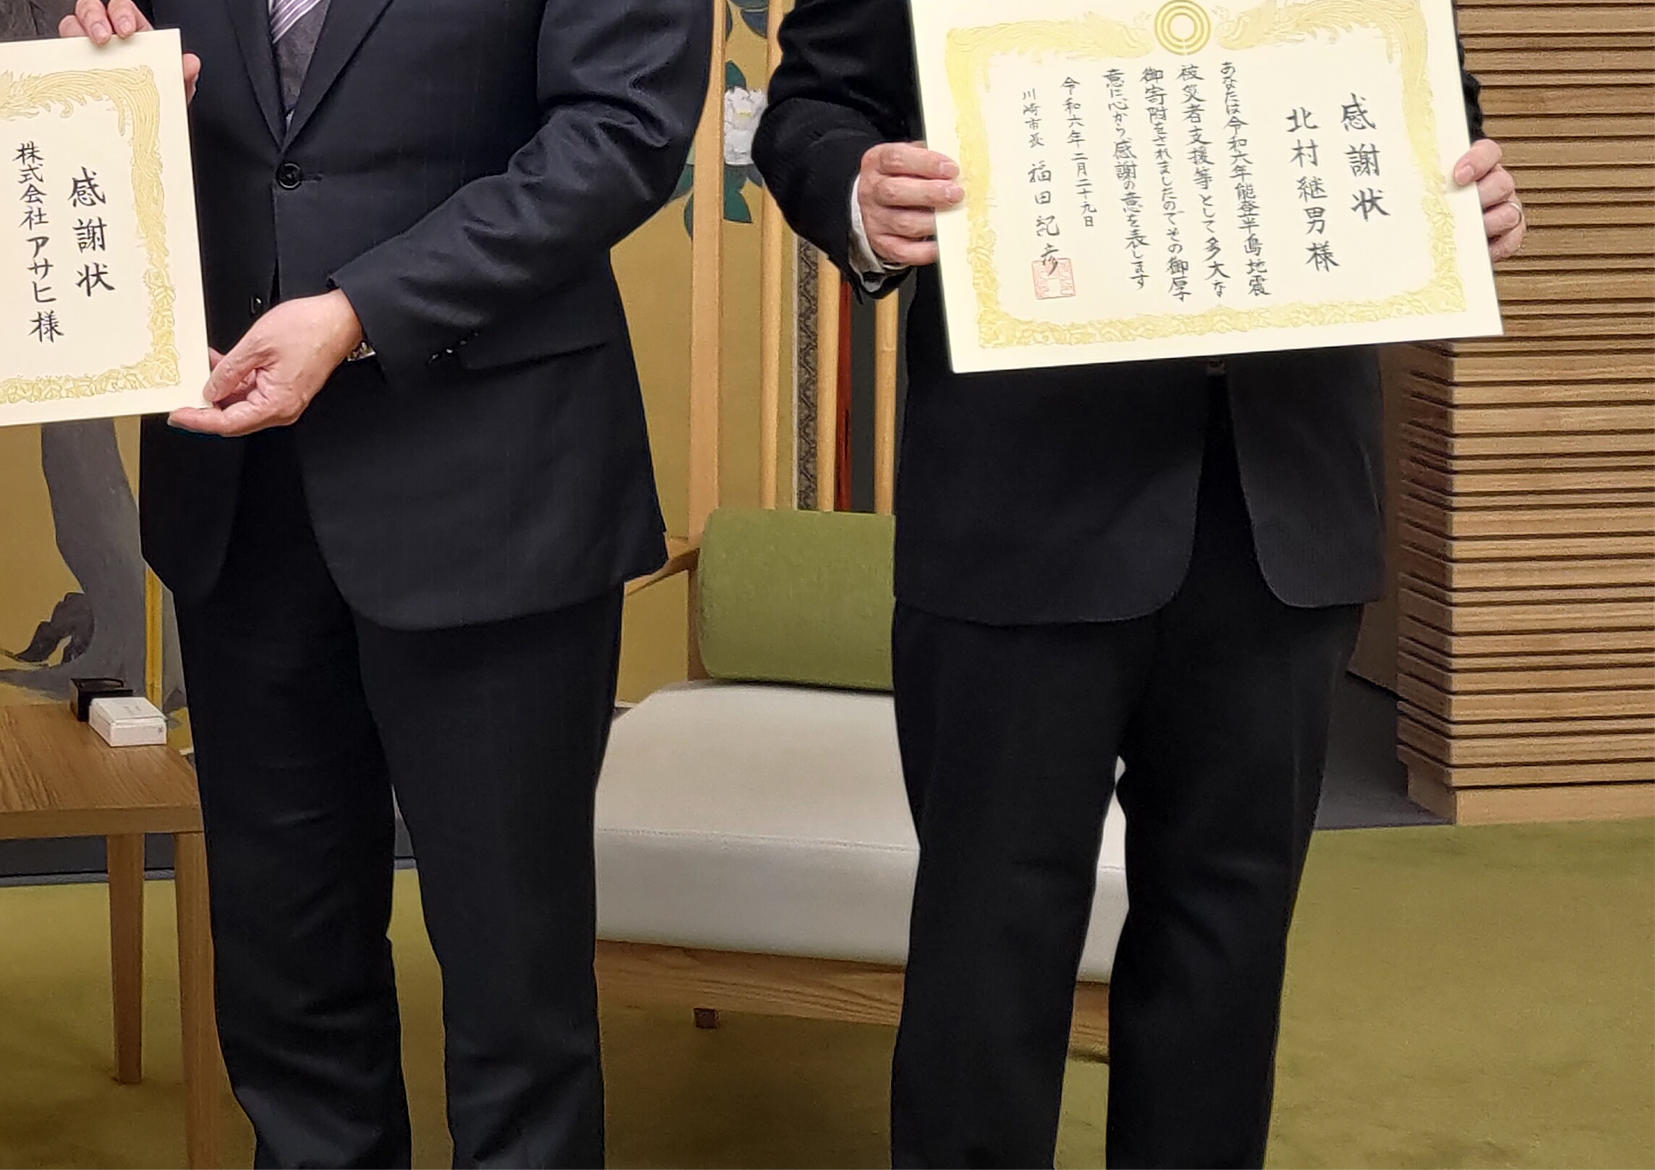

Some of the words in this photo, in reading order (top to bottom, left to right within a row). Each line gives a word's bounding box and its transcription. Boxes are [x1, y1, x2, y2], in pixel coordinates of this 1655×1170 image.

[1286, 106, 1339, 272] 北村継男様
[1341, 92, 1390, 220] 感謝状
[68, 166, 116, 298] 感謝状
